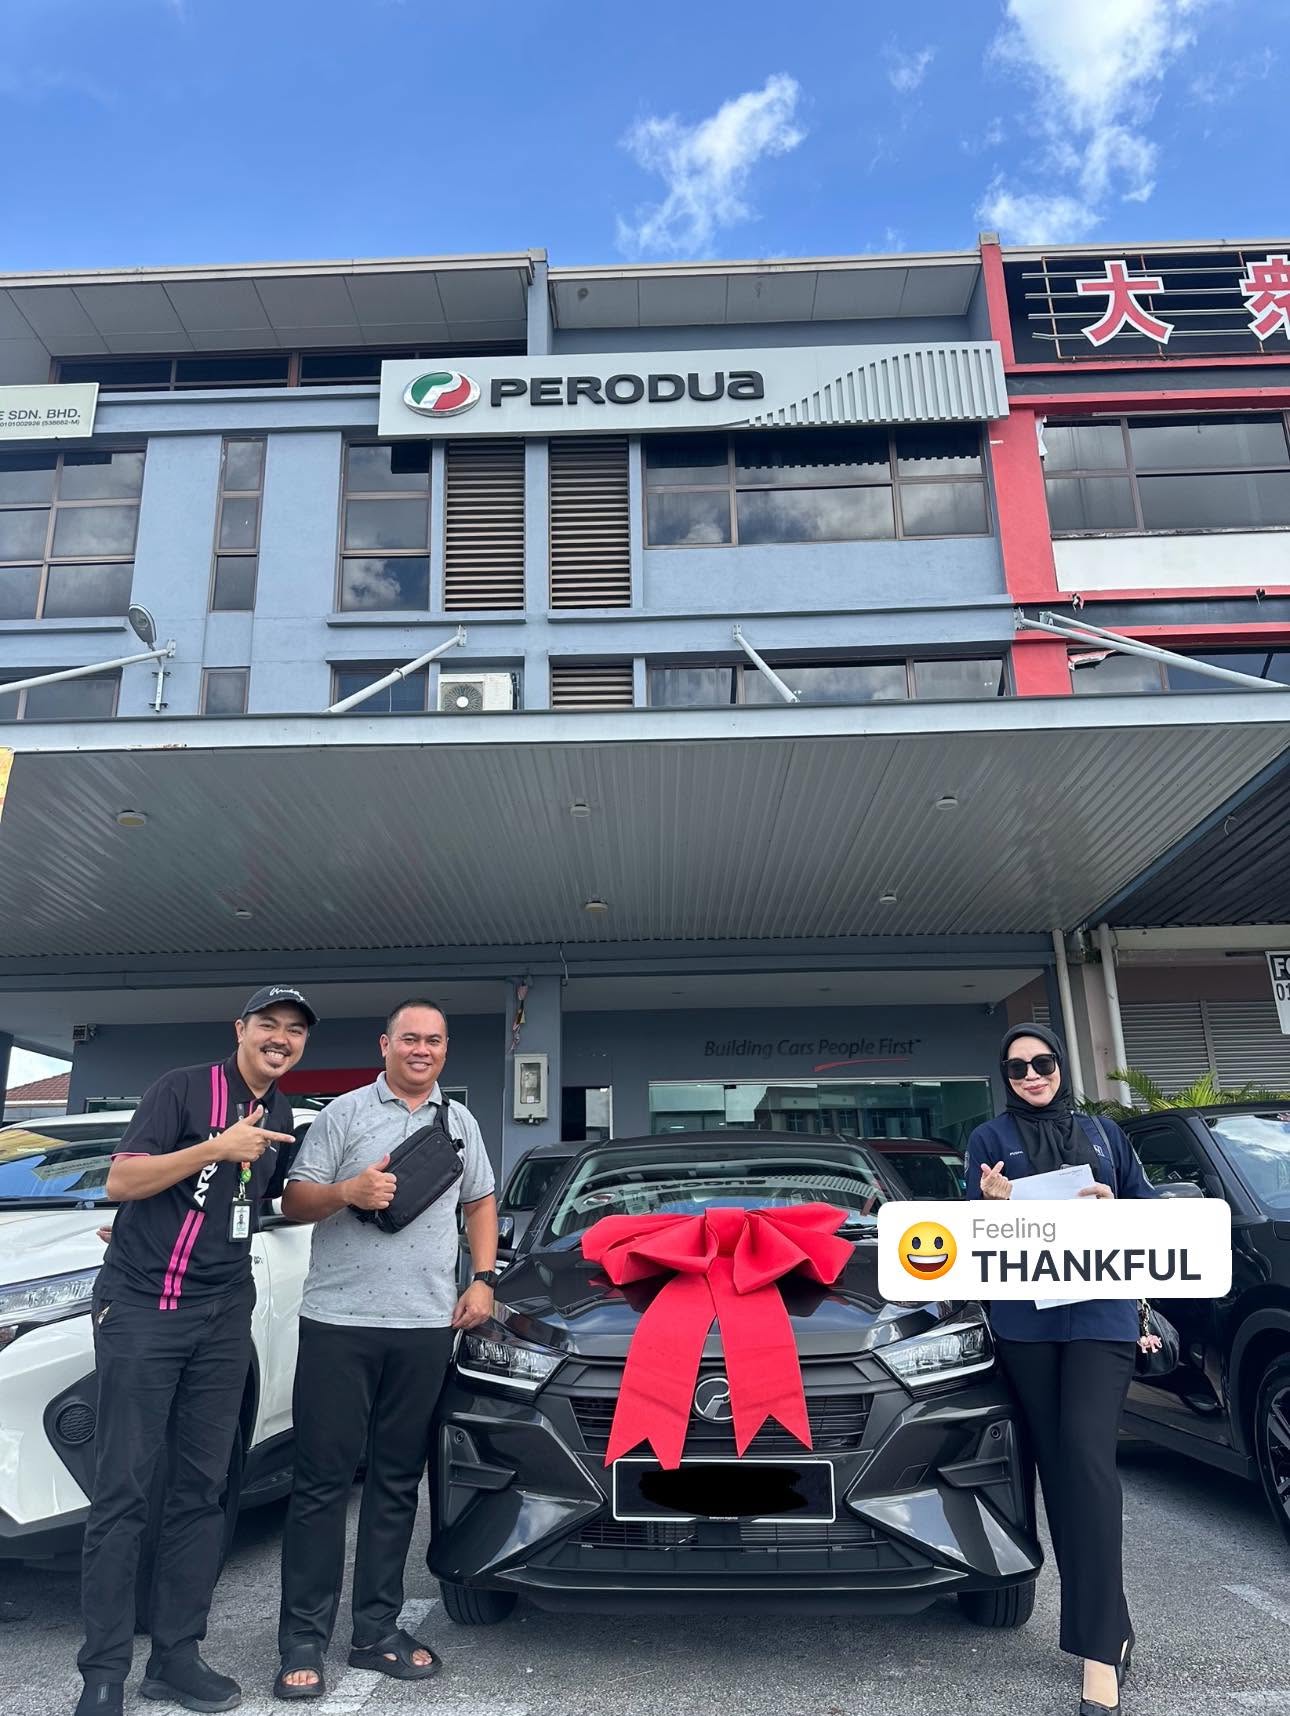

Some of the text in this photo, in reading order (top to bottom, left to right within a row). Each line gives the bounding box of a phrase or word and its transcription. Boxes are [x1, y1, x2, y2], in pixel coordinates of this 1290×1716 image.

[8, 410, 41, 420] SDN.
[47, 409, 80, 418] BHD.
[704, 1041, 772, 1058] Building
[777, 1040, 814, 1055] Cars
[818, 1038, 875, 1057] People
